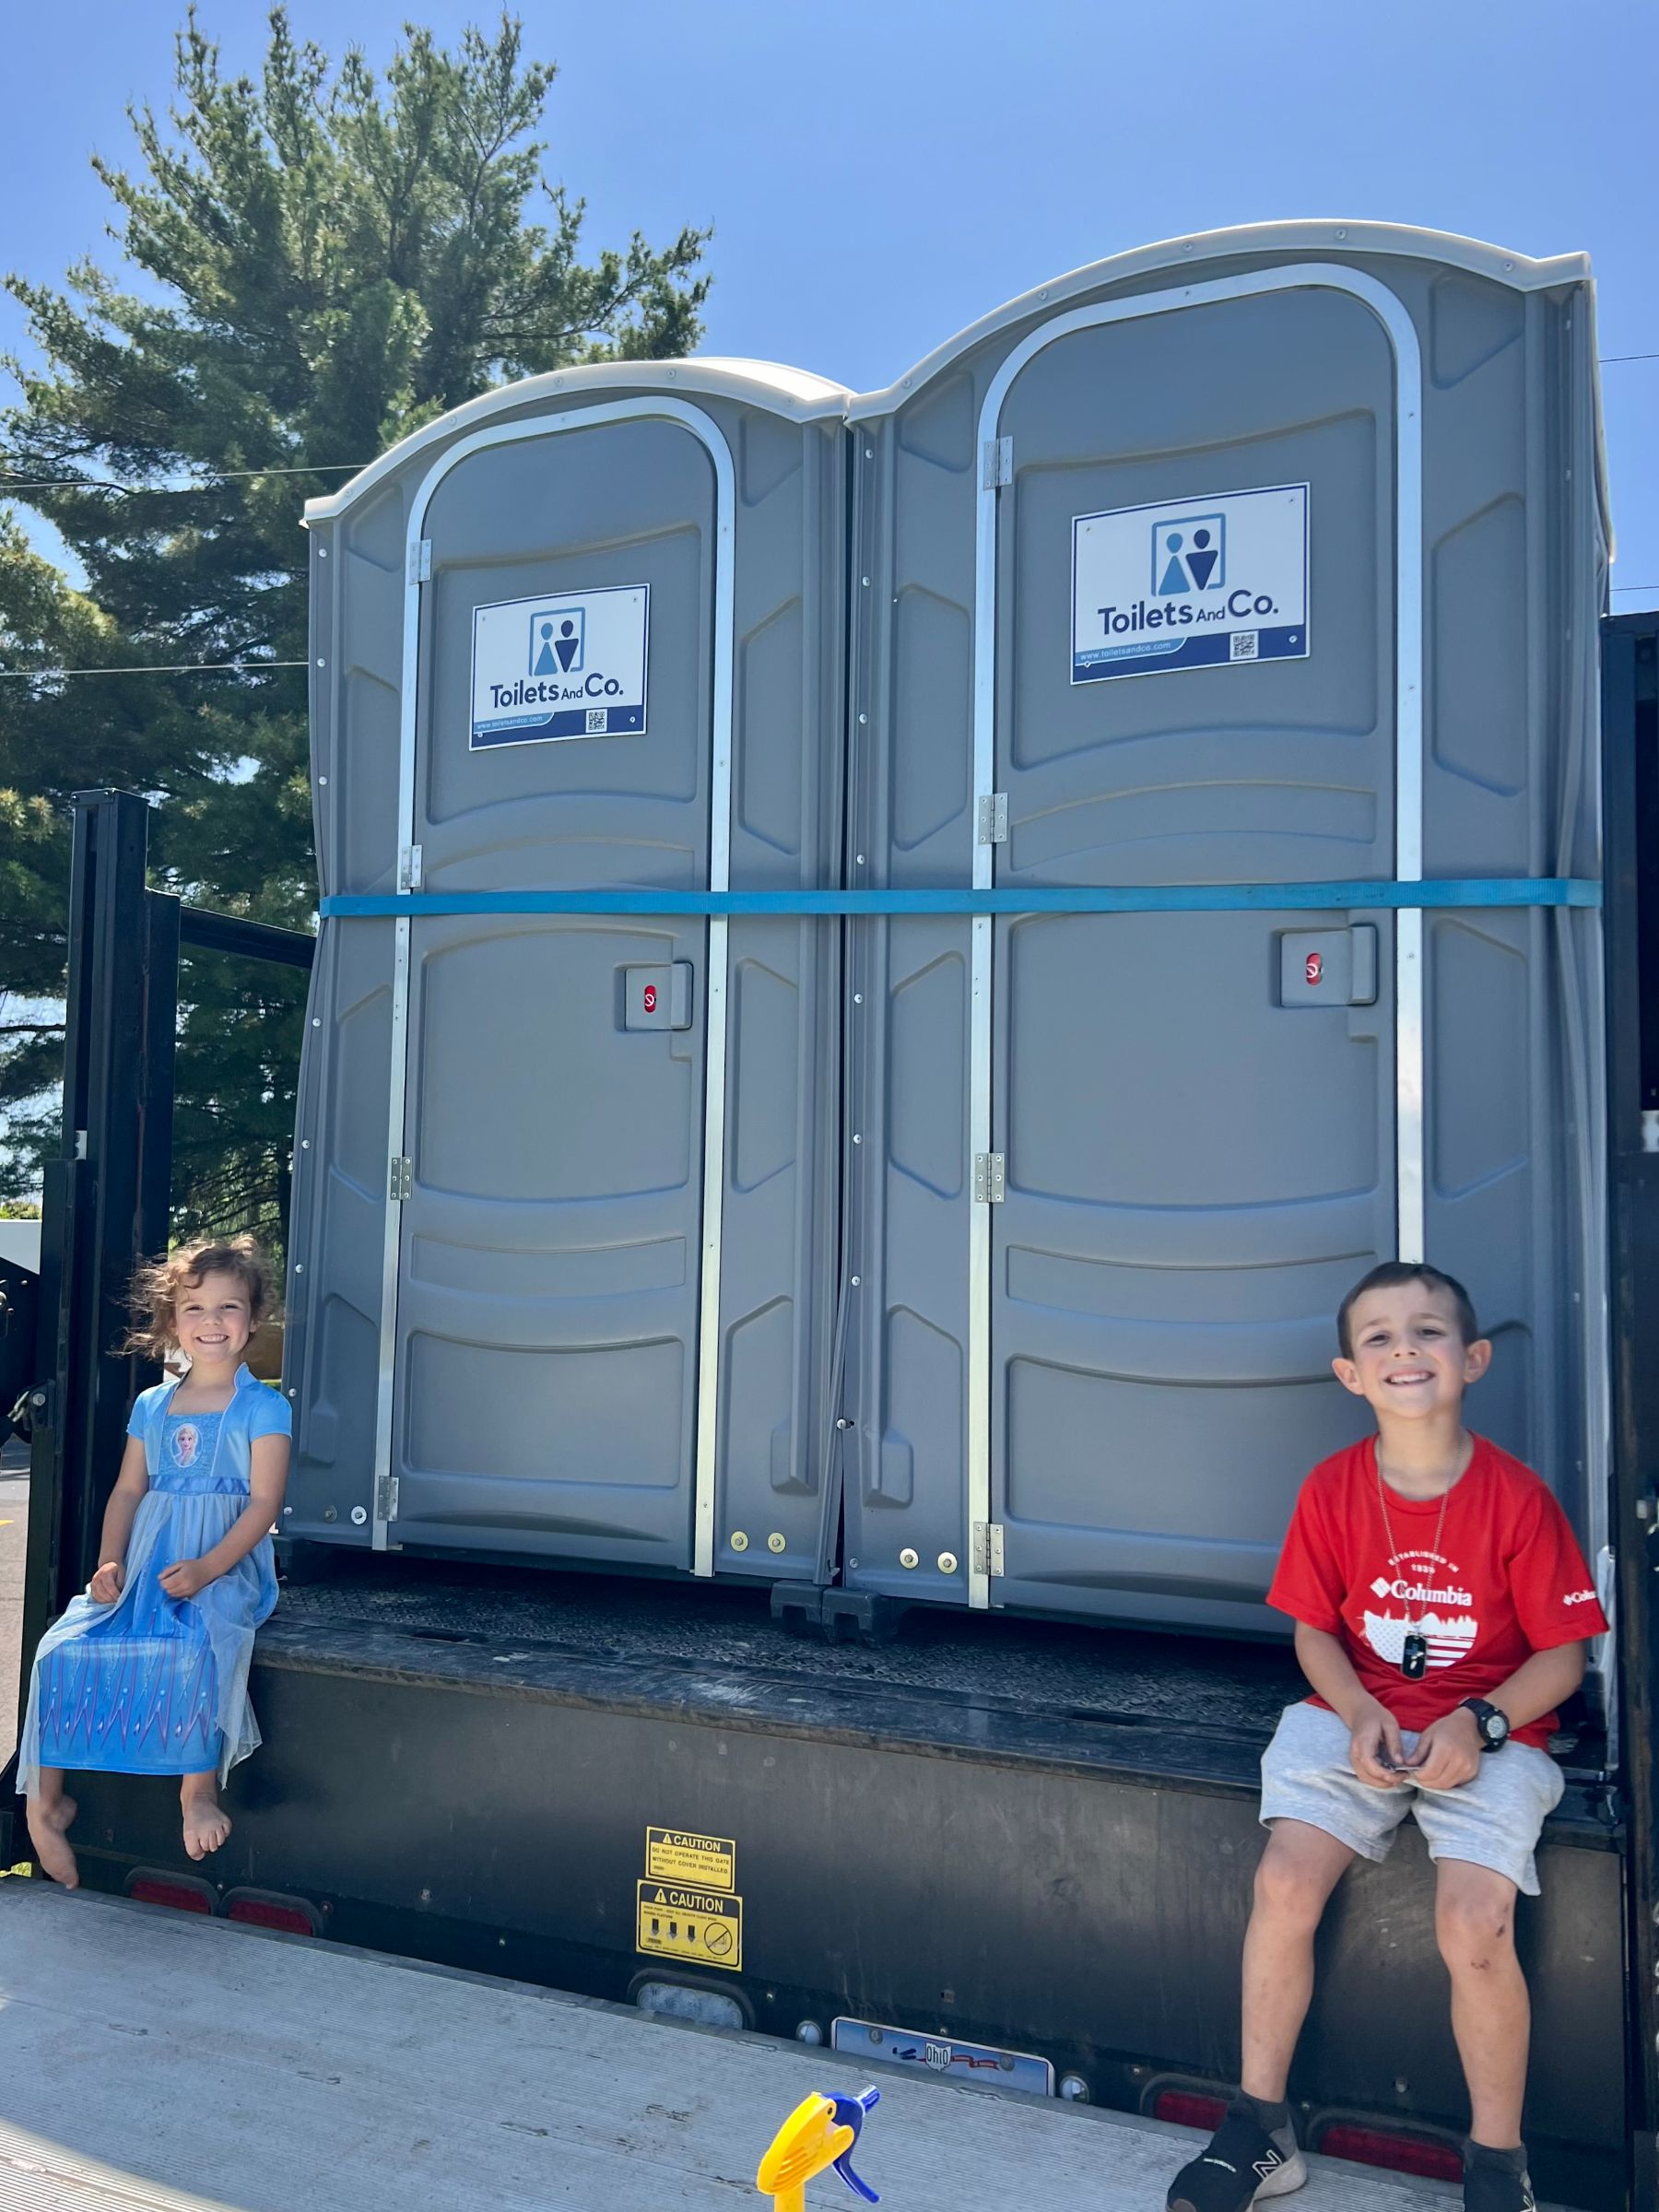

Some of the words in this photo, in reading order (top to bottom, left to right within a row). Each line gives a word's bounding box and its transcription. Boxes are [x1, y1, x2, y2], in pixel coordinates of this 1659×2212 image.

[1098, 601, 1193, 635] Toilets
[1196, 606, 1226, 622] And
[1228, 590, 1278, 618] Co.
[1080, 642, 1171, 660] www.toiletsandco.com
[490, 680, 559, 708] Toilets
[561, 687, 582, 700] And
[584, 673, 623, 697] Co.
[1391, 1579, 1472, 1606] Columbia
[674, 1835, 721, 1853] CAUTION
[653, 1856, 677, 1865] WITHOUT
[678, 1860, 697, 1868] COVER
[699, 1864, 728, 1874] INSTALLED
[675, 1851, 699, 1860] OPERATE
[669, 1891, 724, 1913] CAUTION
